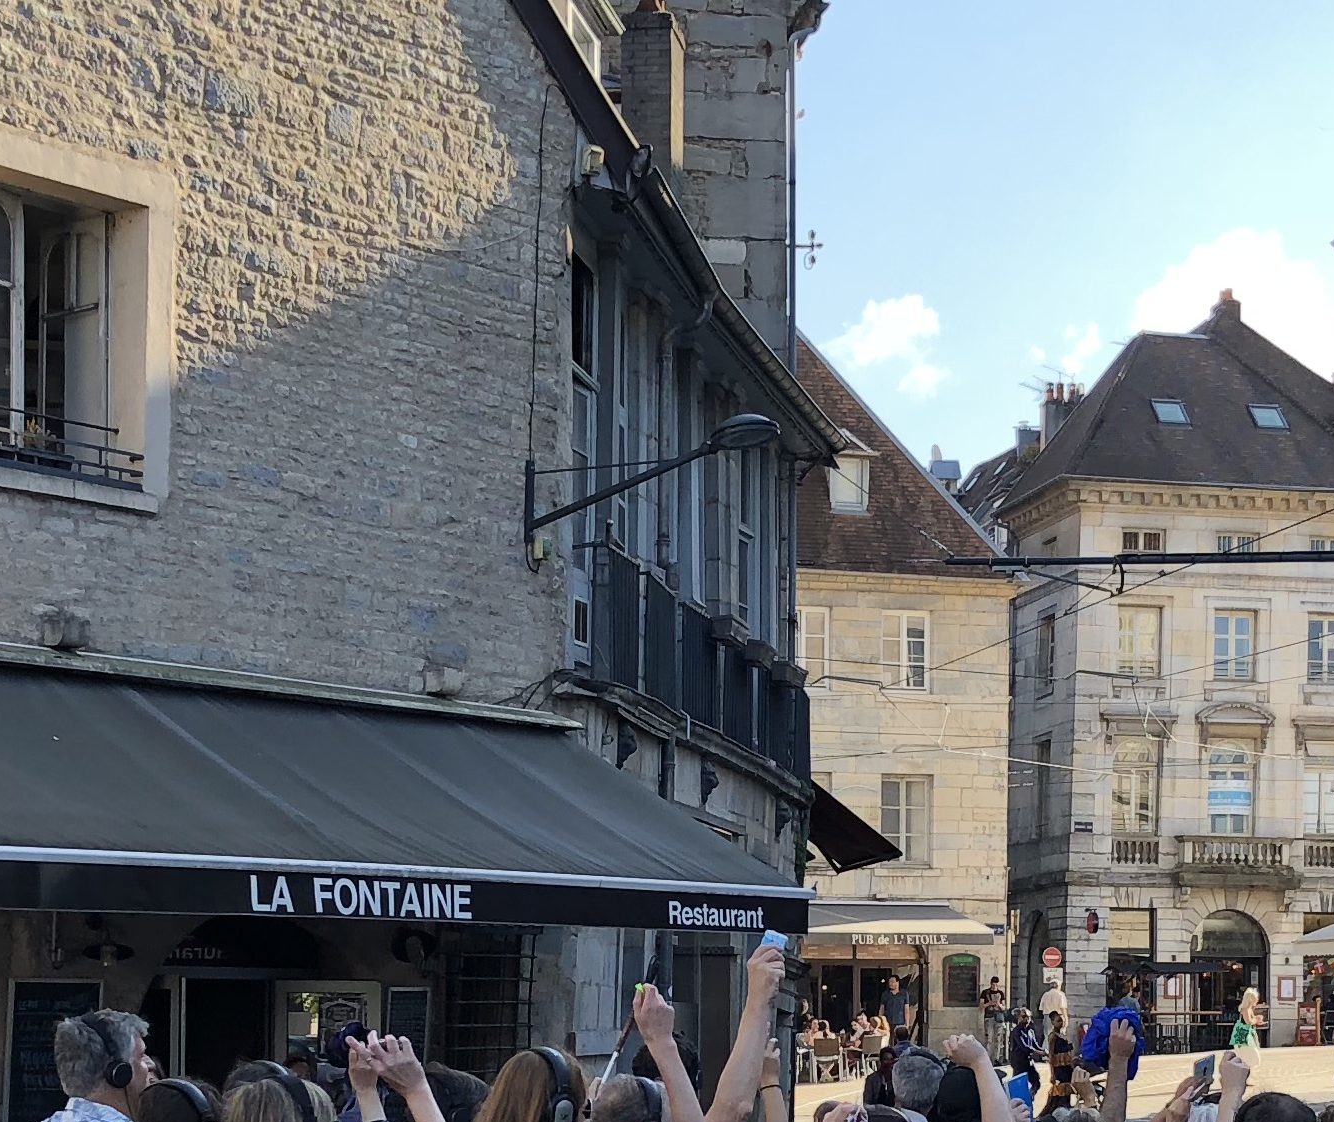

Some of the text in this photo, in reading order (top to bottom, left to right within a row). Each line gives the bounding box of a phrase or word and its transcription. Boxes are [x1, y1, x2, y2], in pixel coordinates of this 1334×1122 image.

[249, 874, 472, 920] LA FONTAINE
[668, 900, 765, 929] Restaurant
[851, 933, 874, 946] PUB
[877, 934, 890, 946] de
